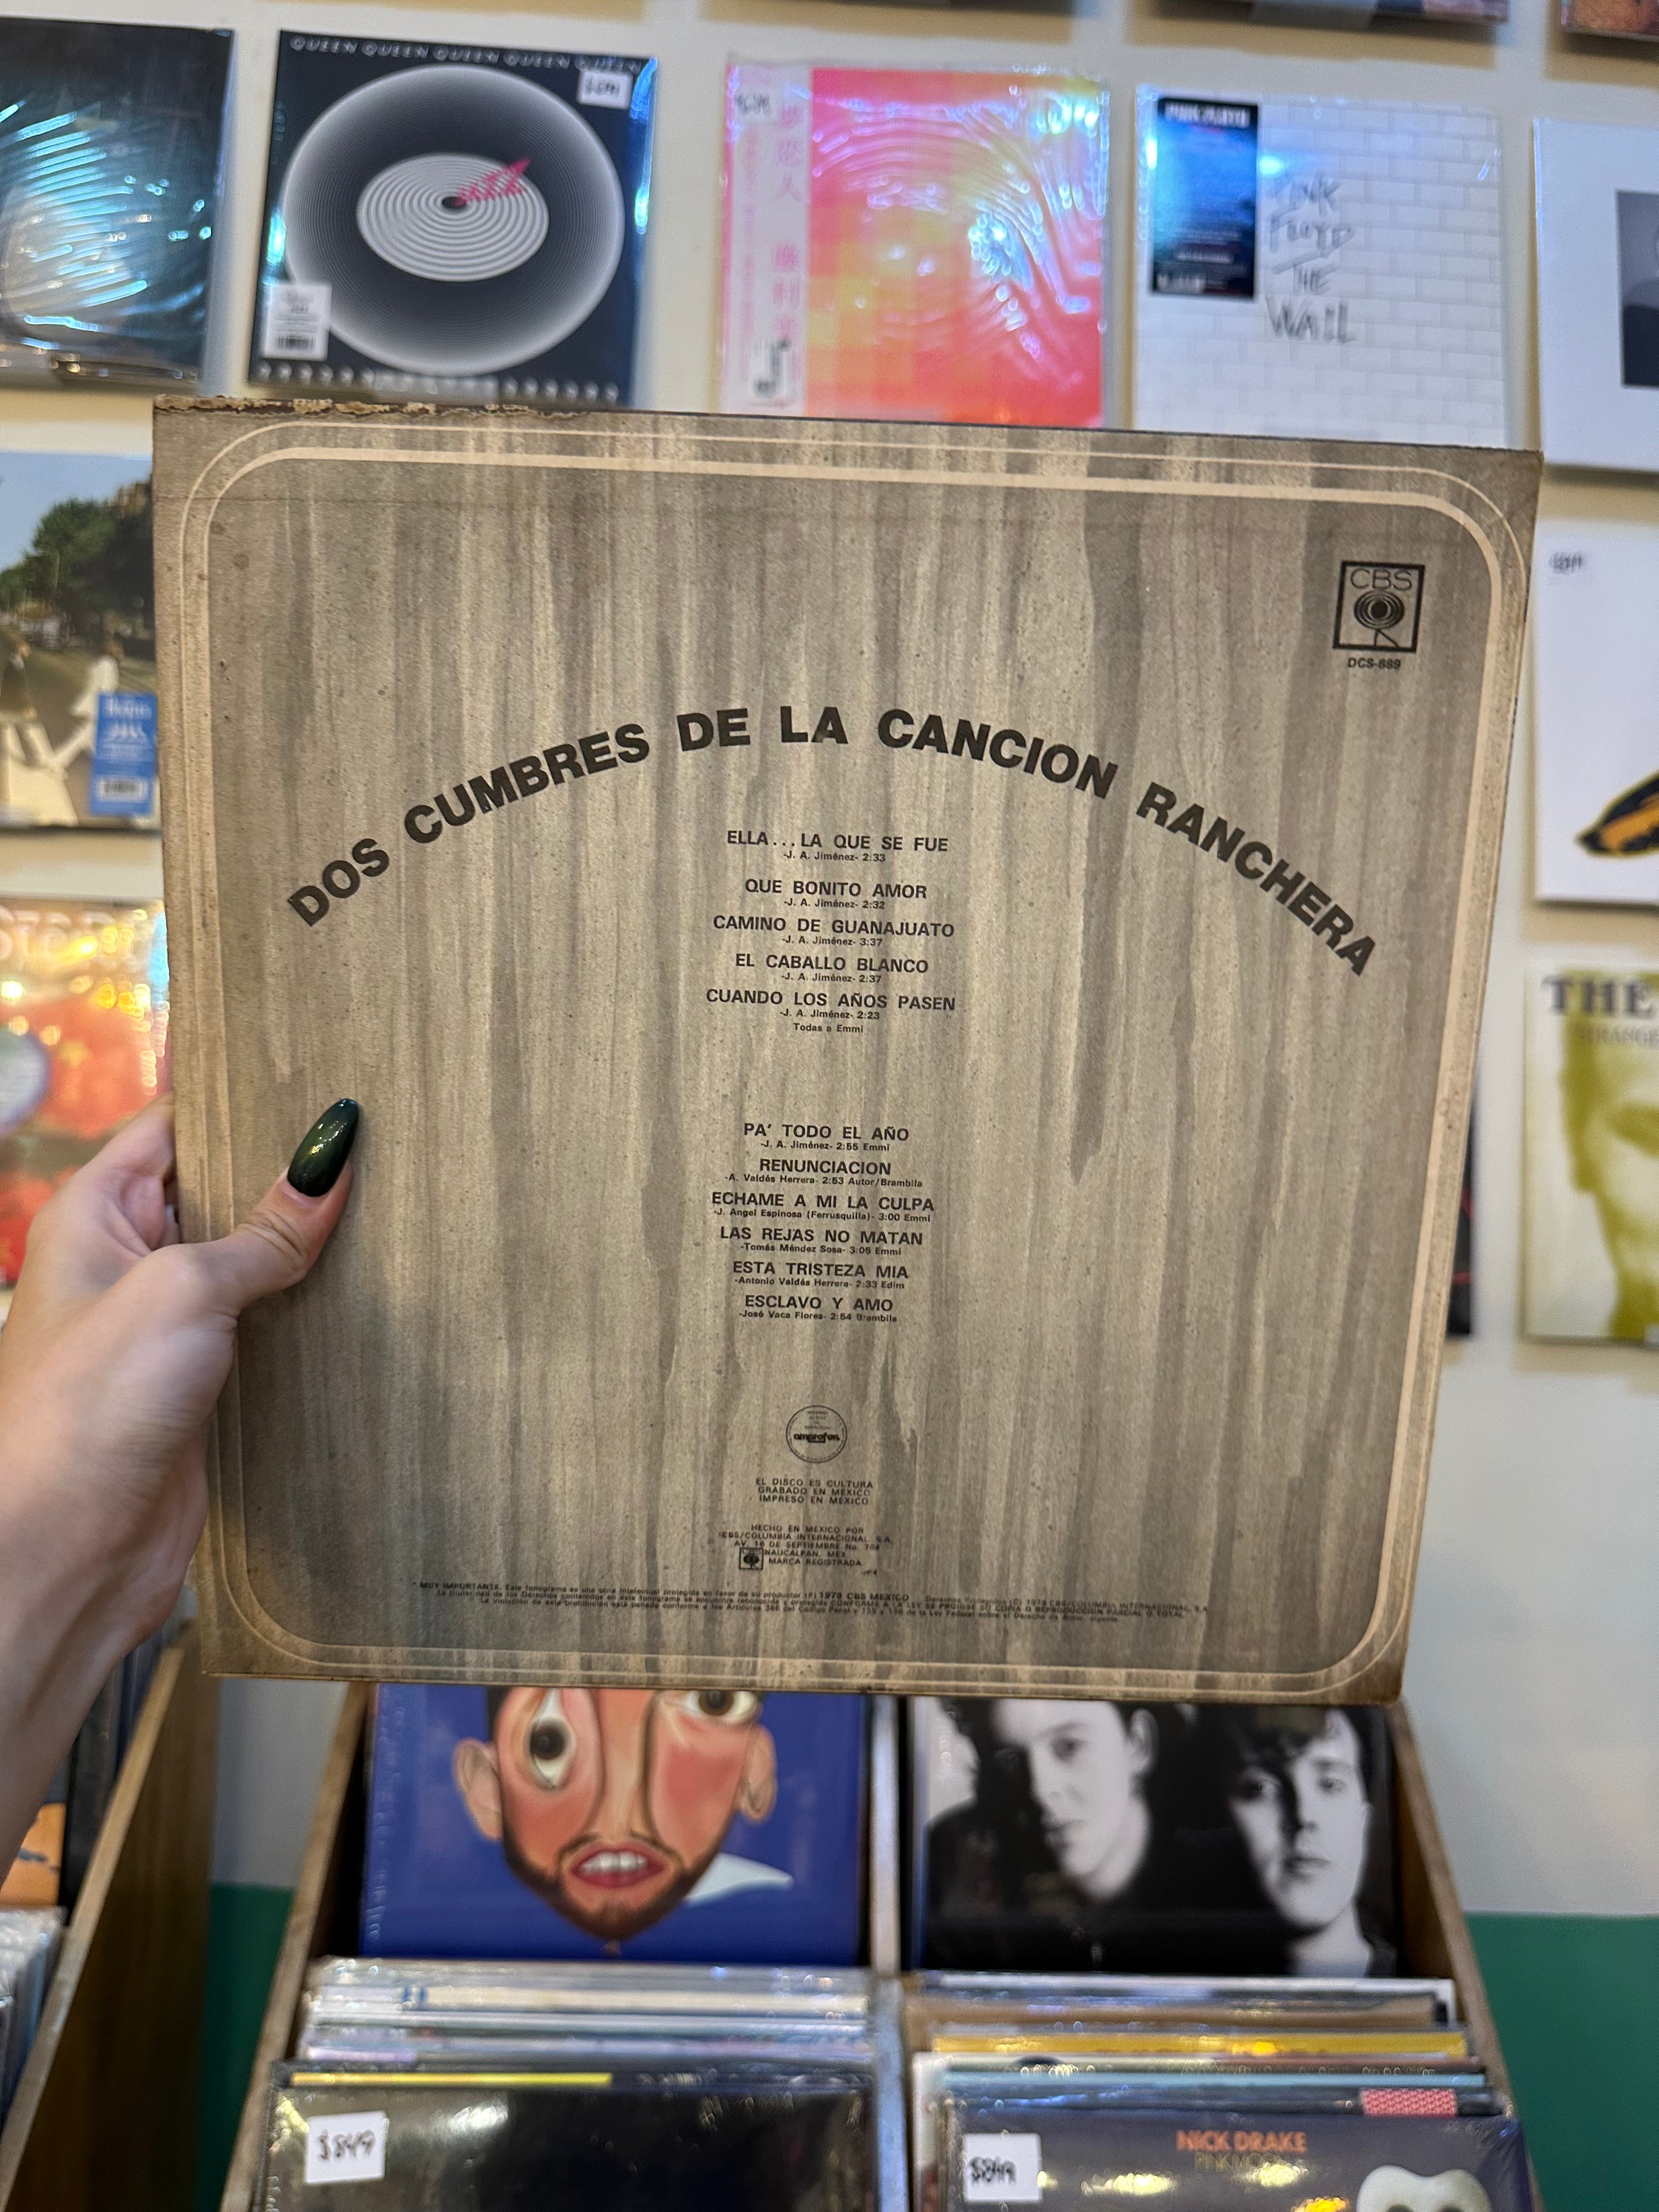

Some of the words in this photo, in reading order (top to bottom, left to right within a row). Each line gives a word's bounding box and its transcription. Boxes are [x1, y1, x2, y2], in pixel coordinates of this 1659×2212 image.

[290, 35, 358, 55] QUEEN
[361, 40, 428, 58] QUEEN
[433, 45, 500, 64] QUEEN
[503, 50, 571, 69] QUEEN
[1350, 568, 1412, 591] CBS
[1347, 657, 1401, 670] DCS-889
[287, 838, 390, 927] DOS
[404, 724, 650, 845] CUMBRES
[676, 708, 751, 752] DE
[780, 706, 848, 744] LA
[878, 709, 1118, 799] CANCION
[1136, 780, 1375, 977] RANCHERA
[834, 834, 870, 849] QUE
[882, 836, 903, 850] SE
[914, 837, 948, 851] FUE
[800, 851, 810, 859] A.
[814, 851, 858, 861] Jiménez-
[862, 853, 885, 862] 2:33
[745, 879, 782, 893] QUE
[793, 881, 861, 896] BONITO
[872, 884, 927, 899] AMOR
[800, 898, 810, 906] A.
[815, 899, 858, 908] Jiménez-
[862, 900, 885, 910] 2:32
[714, 915, 786, 931] CAMINO
[798, 918, 821, 932] DE
[832, 919, 954, 937] GUANAJUATO
[812, 936, 856, 945] Jiménez-
[860, 938, 882, 946] 3:37
[736, 953, 755, 967] EL
[766, 955, 845, 970] CABALLO
[857, 958, 928, 973] BLANCO
[812, 973, 855, 982] Jiménez-
[859, 975, 881, 983] 2:37
[706, 989, 783, 1005] CUANDO
[794, 992, 827, 1006] LOS
[838, 993, 887, 1008] AÑOS
[898, 996, 955, 1011] PASEN
[1541, 974, 1657, 1018] THE
[810, 1009, 853, 1018] Jiménez-
[857, 1011, 880, 1019] 2:23
[793, 1023, 822, 1031] Todas
[837, 1024, 863, 1033] Emmi
[744, 1123, 772, 1136] PA'
[782, 1124, 831, 1138] TODO
[843, 1126, 861, 1139] EL
[871, 1126, 909, 1141] AÑO
[791, 1141, 832, 1149] Jiménez-
[836, 1142, 858, 1150] 2:55
[864, 1143, 889, 1152] Emmi
[760, 1159, 891, 1175] RENUNCIACION
[743, 1173, 775, 1182] Valdés
[712, 1192, 784, 1206] ECHAME
[794, 1194, 806, 1207] A
[817, 1195, 837, 1207] MI
[848, 1196, 868, 1209] LA
[878, 1197, 934, 1211] CULPA
[730, 1208, 757, 1217] Angel
[761, 1209, 802, 1218] Espinosa
[878, 1213, 900, 1221] 3:00
[904, 1214, 930, 1222] Emmi
[720, 1226, 751, 1239] LAS
[762, 1228, 814, 1242] REJAS
[825, 1230, 849, 1243] NO
[861, 1231, 923, 1245] MATAN
[850, 1246, 871, 1255] 3:05
[875, 1247, 901, 1255] Emmi
[733, 1261, 775, 1274] ESTA
[786, 1262, 865, 1277] TRISTEZA
[876, 1266, 909, 1278] MIA
[735, 1277, 775, 1285] -Antonio
[779, 1278, 810, 1286] Valdés
[814, 1279, 851, 1288] Herrera-
[856, 1280, 877, 1288] 2:33
[881, 1281, 904, 1289] Edim
[746, 1295, 821, 1309] ESCLAVO
[832, 1297, 843, 1309] Y
[853, 1298, 893, 1311] AMO
[756, 1477, 766, 1486] EL
[827, 1480, 873, 1488] CULTURA
[758, 1486, 807, 1494] GRABADO
[832, 1488, 870, 1497] MEXICO
[759, 1494, 804, 1503] IMPRESO
[830, 1497, 868, 1505] MEXICO
[805, 1559, 862, 1567] REGISTRADA
[1176, 2129, 1231, 2153] NICK
[1234, 2130, 1307, 2153] DRAKE
